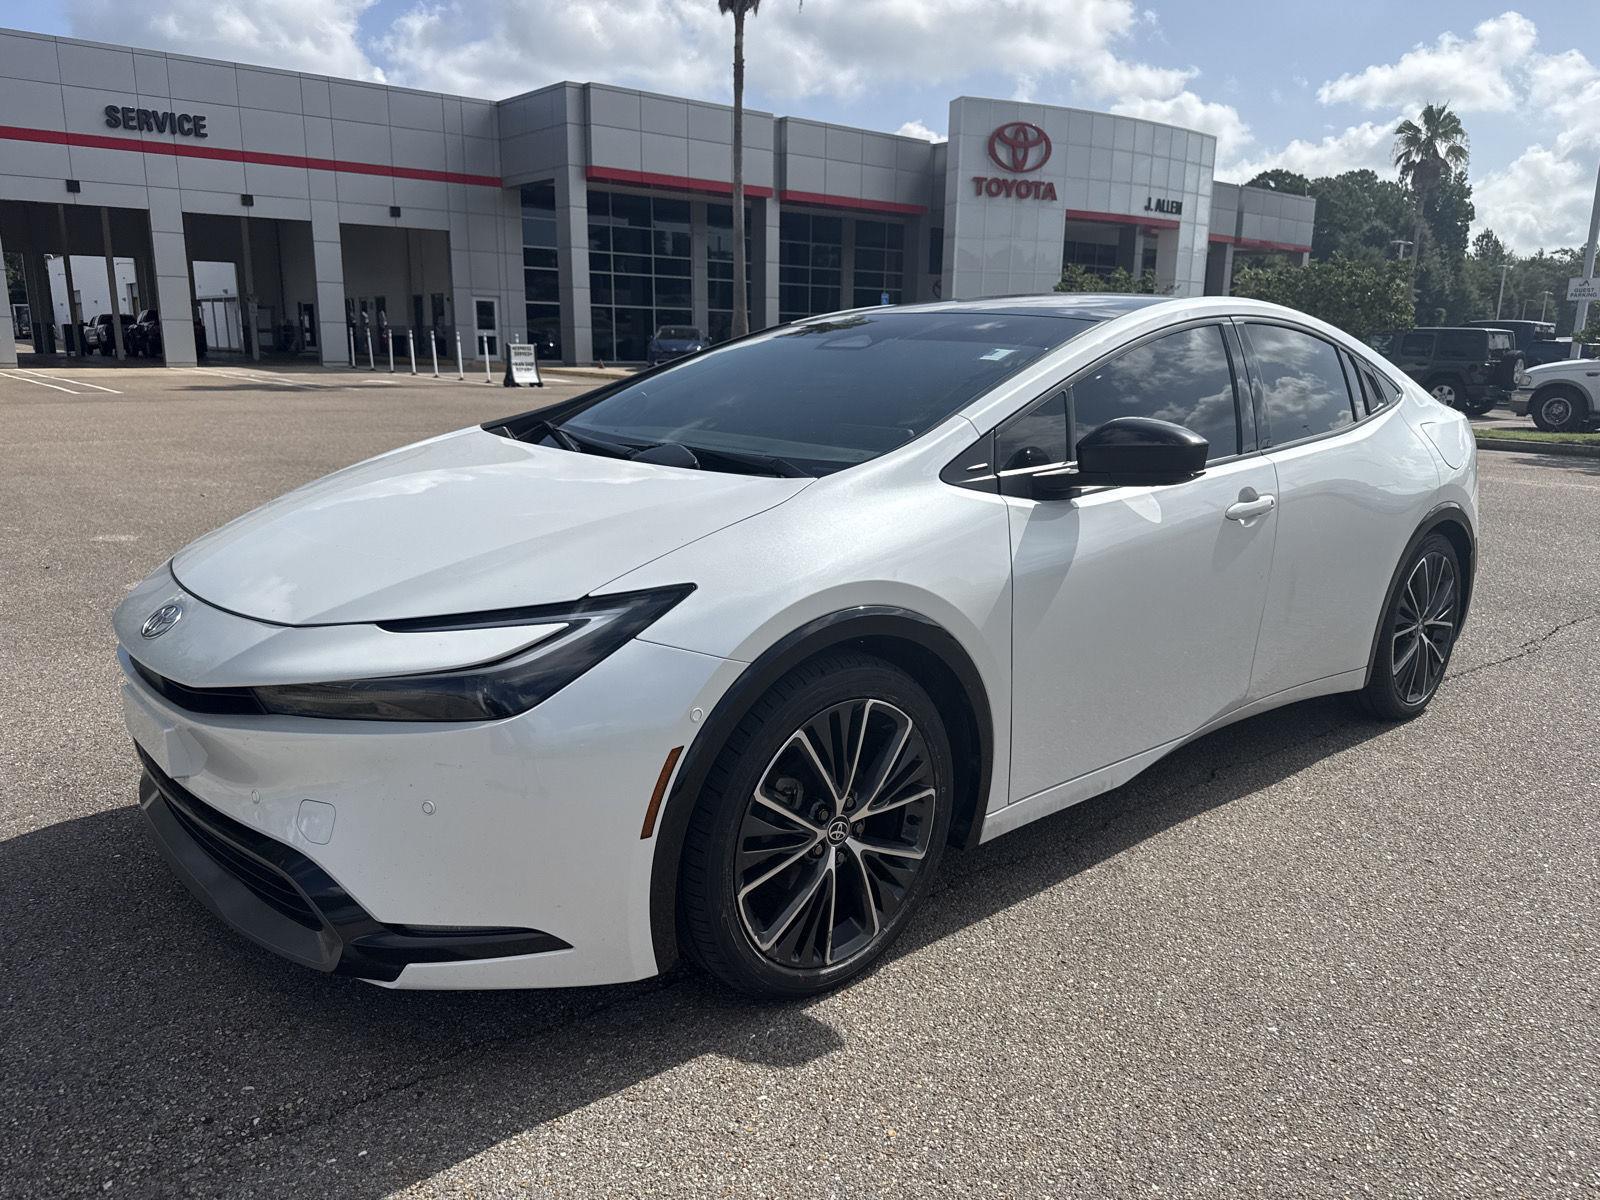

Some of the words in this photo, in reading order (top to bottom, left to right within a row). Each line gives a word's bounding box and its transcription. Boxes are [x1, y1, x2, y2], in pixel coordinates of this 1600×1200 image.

[104, 105, 208, 138] SERVICE
[972, 176, 1058, 201] TOYOTA
[1144, 197, 1153, 212] J.
[1154, 199, 1183, 215] ALLEN
